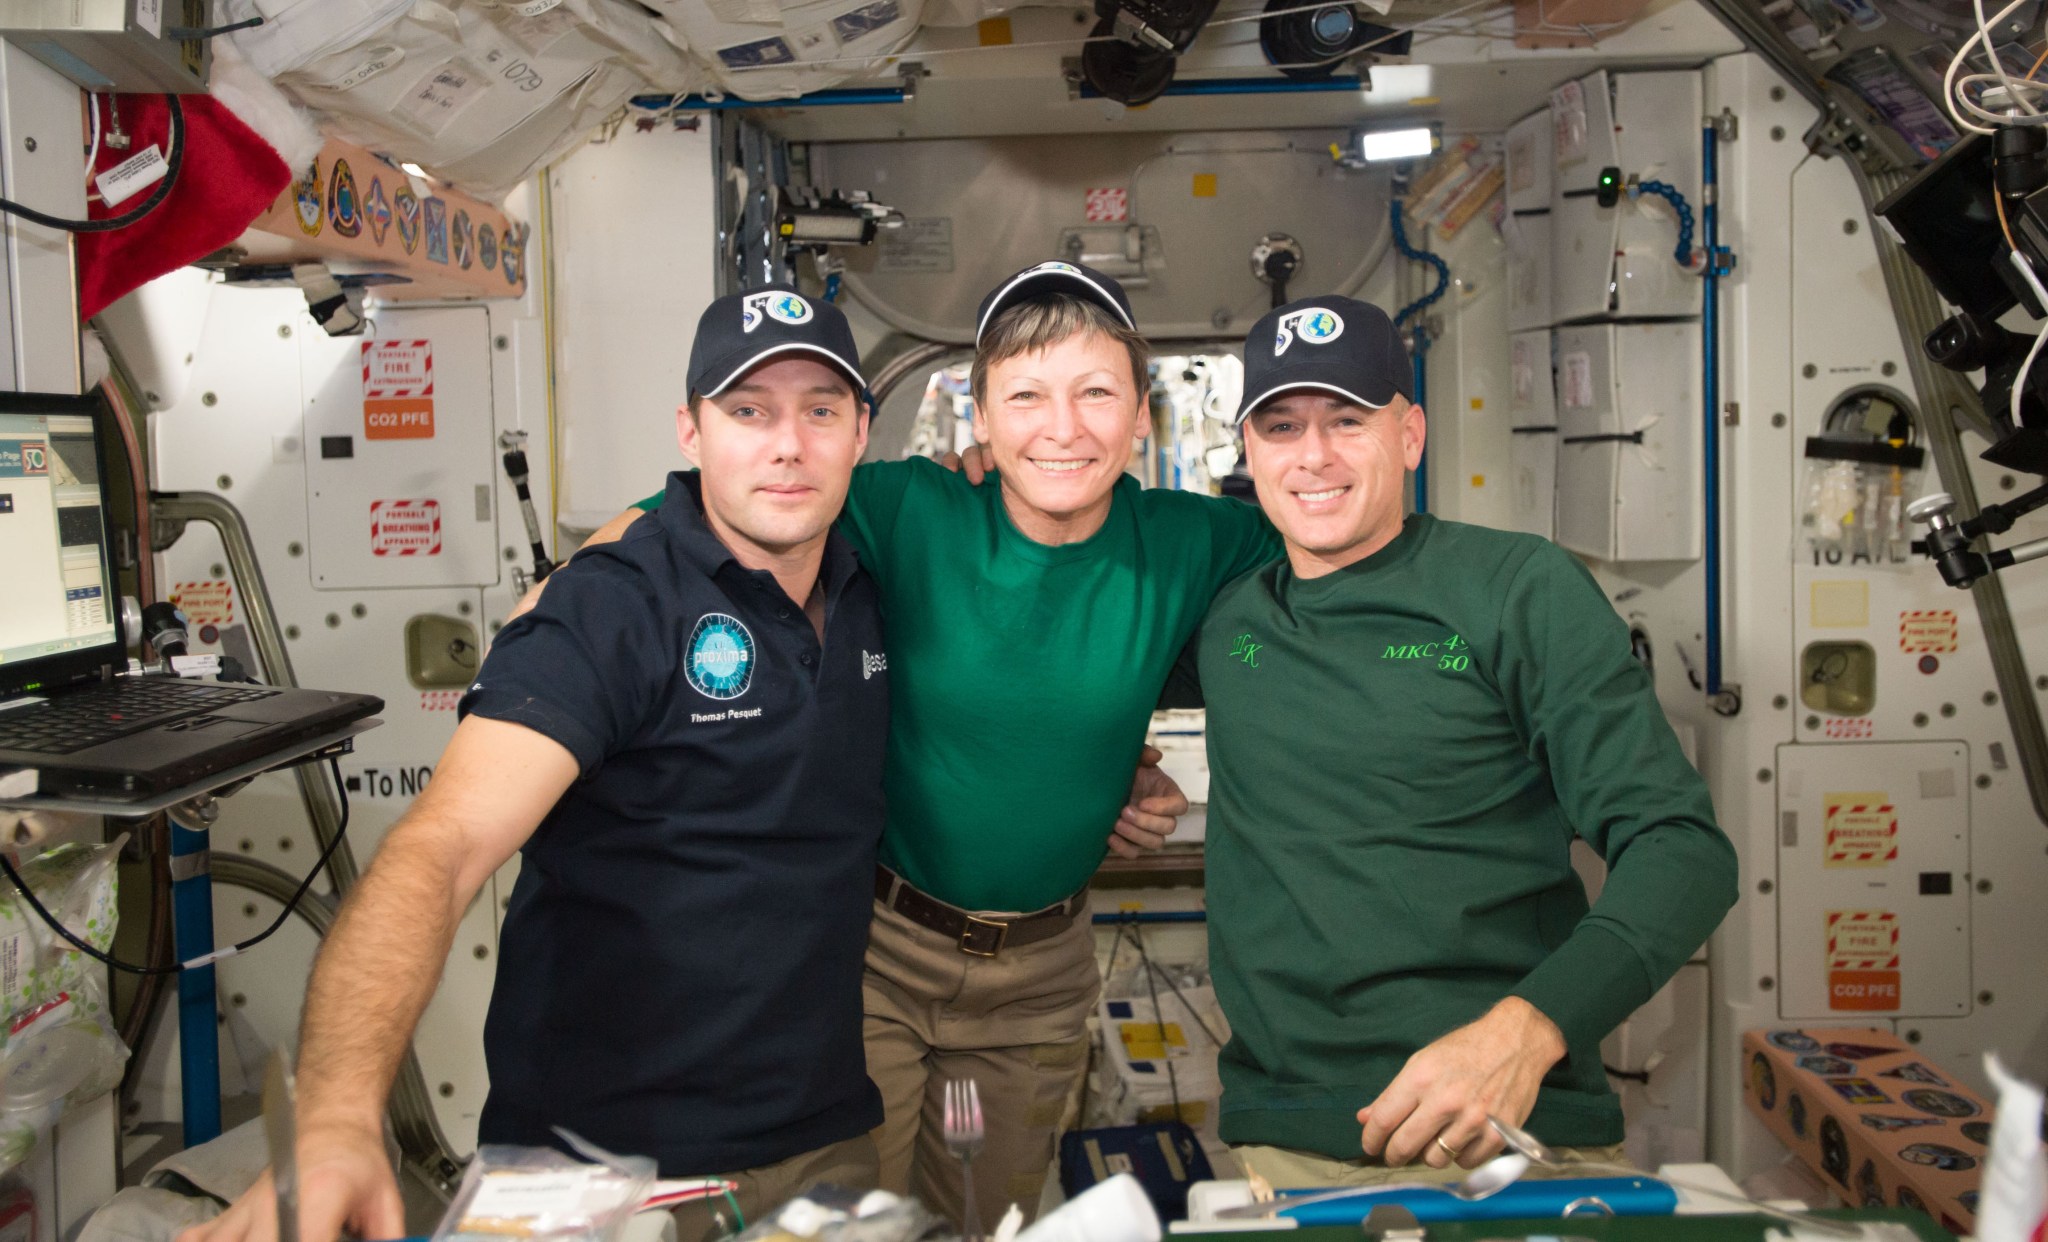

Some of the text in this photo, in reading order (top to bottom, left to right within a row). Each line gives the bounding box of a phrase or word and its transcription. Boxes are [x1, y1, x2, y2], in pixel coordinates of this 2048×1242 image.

[500, 58, 543, 92] 1079
[384, 362, 410, 374] FIRE
[369, 411, 429, 427] CO2 PFE
[386, 511, 425, 519] PORTABLE
[382, 523, 430, 534] BREATHING
[384, 538, 429, 546] APPARATUS
[694, 648, 749, 670] proxima
[1437, 654, 1469, 672] 50
[690, 707, 762, 723] Thomas Pesquet
[364, 768, 393, 798] To
[1850, 936, 1878, 946] FIRE
[1834, 984, 1897, 998] CO2 PFE
